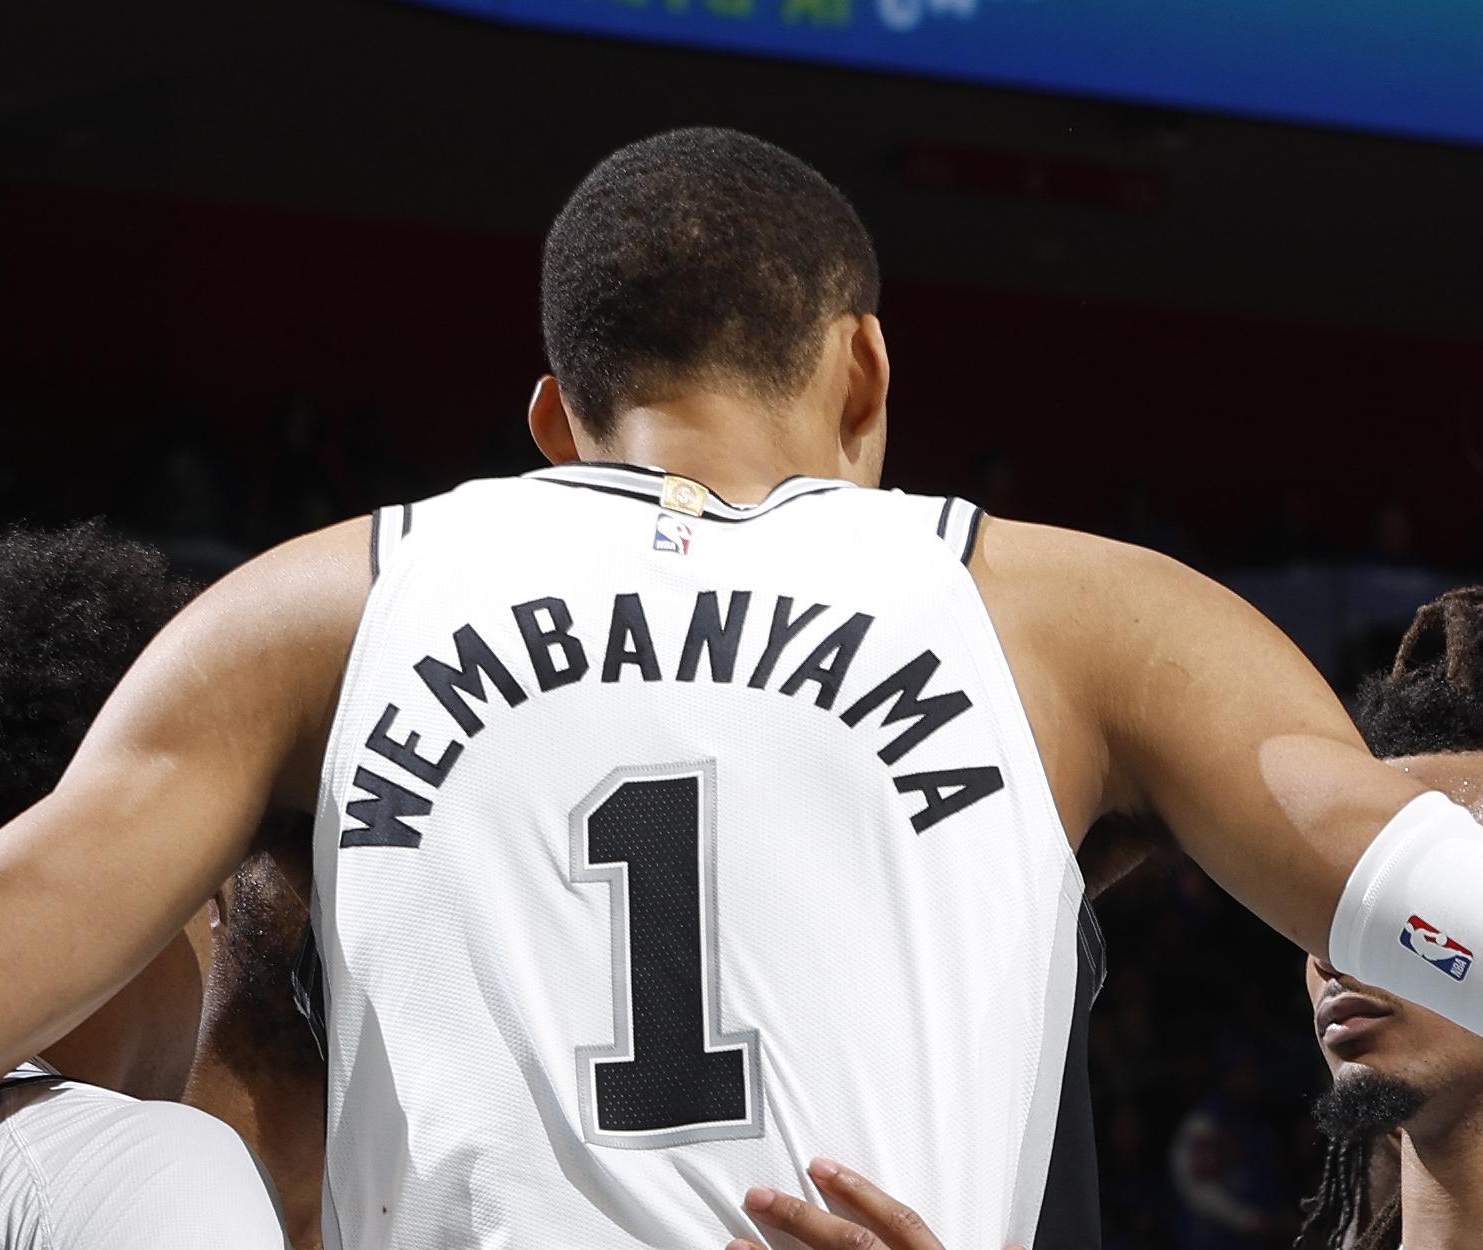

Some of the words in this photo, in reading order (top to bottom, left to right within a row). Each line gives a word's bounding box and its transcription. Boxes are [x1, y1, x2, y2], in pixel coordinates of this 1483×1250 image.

[339, 590, 1006, 850] WEMBANYAMA
[569, 756, 765, 1149] 1
[1449, 957, 1468, 978] NBA
